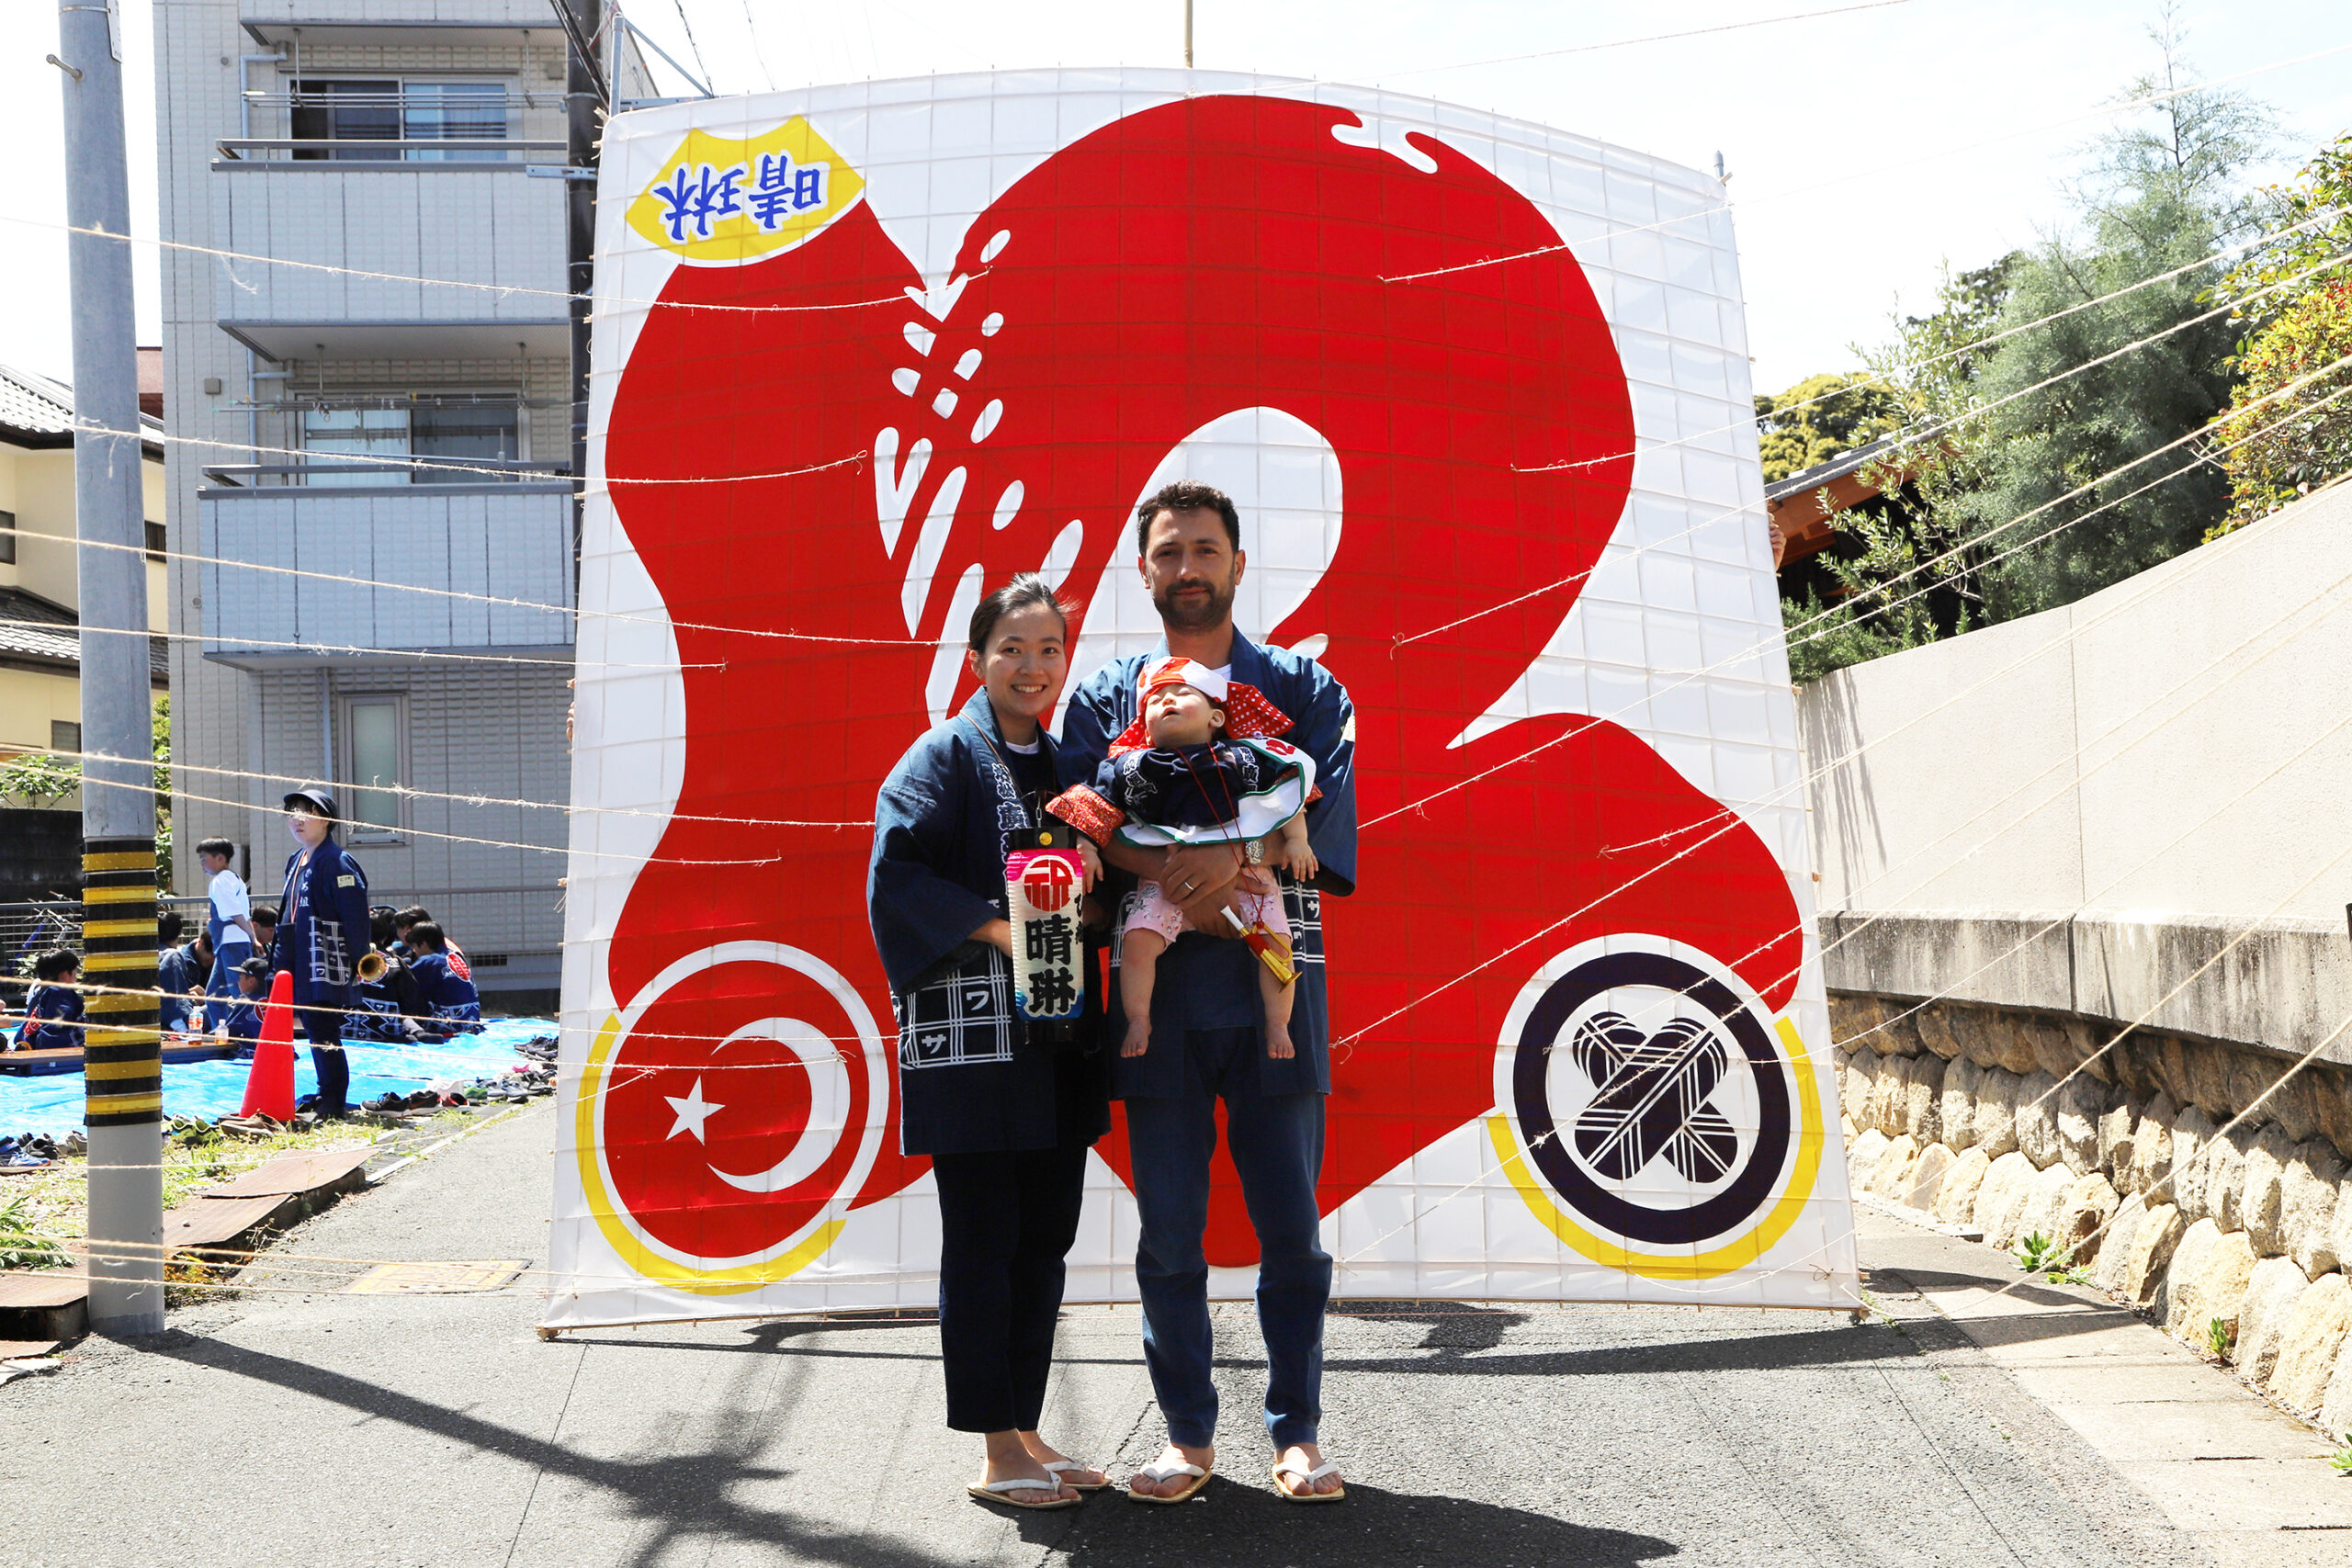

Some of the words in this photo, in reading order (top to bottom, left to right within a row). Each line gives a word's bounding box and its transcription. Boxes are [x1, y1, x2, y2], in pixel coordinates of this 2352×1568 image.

[653, 153, 822, 242] 晴琳
[1024, 913, 1076, 1015] 晴琳
[966, 990, 989, 1011] ワ
[921, 1033, 947, 1055] サ
